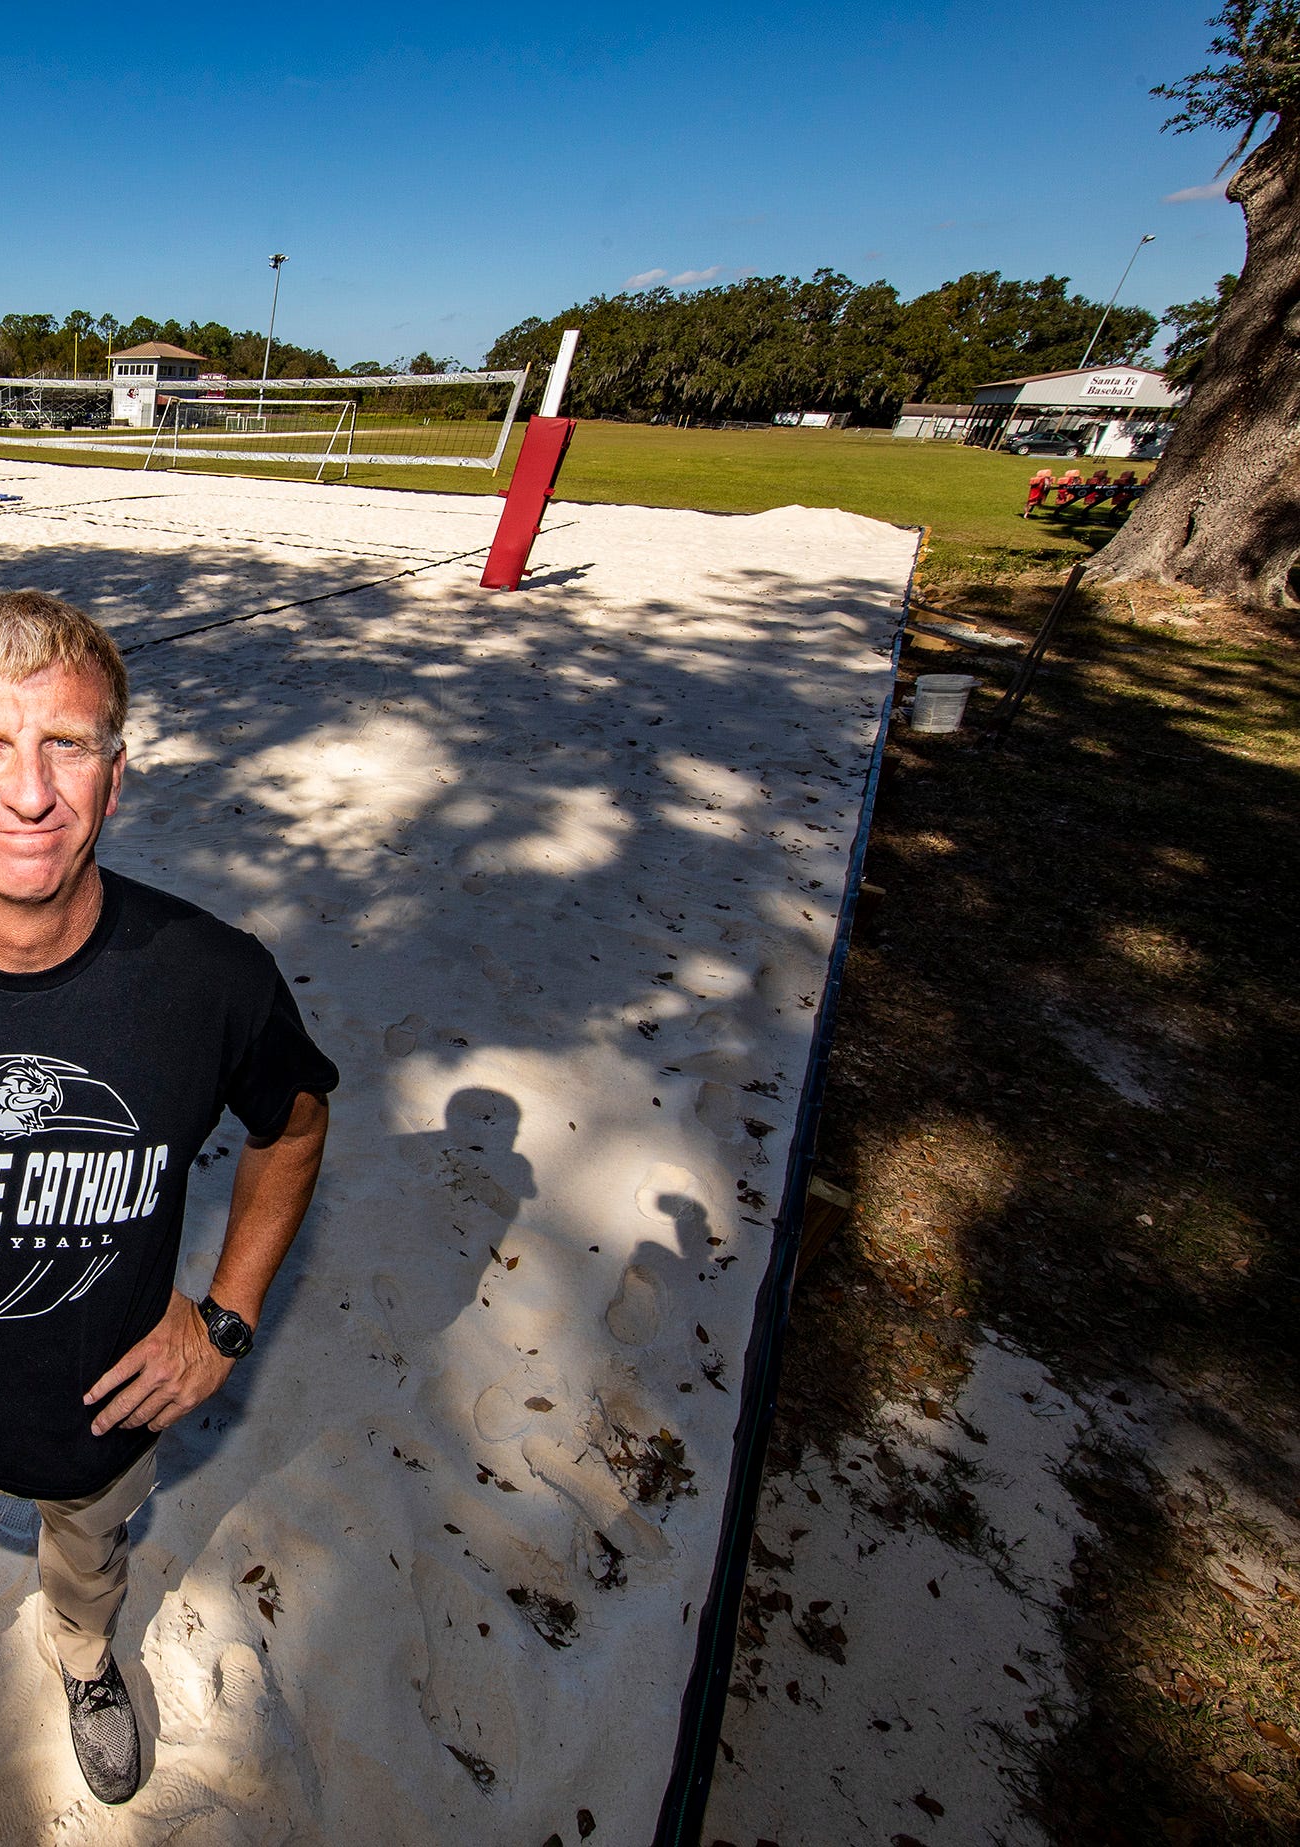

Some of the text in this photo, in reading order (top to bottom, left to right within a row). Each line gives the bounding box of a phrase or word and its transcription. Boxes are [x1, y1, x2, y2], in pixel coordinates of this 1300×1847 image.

[1090, 376, 1139, 386] Santa Fe
[1086, 386, 1133, 396] Baseball
[16, 1144, 169, 1226] CATHOLIC
